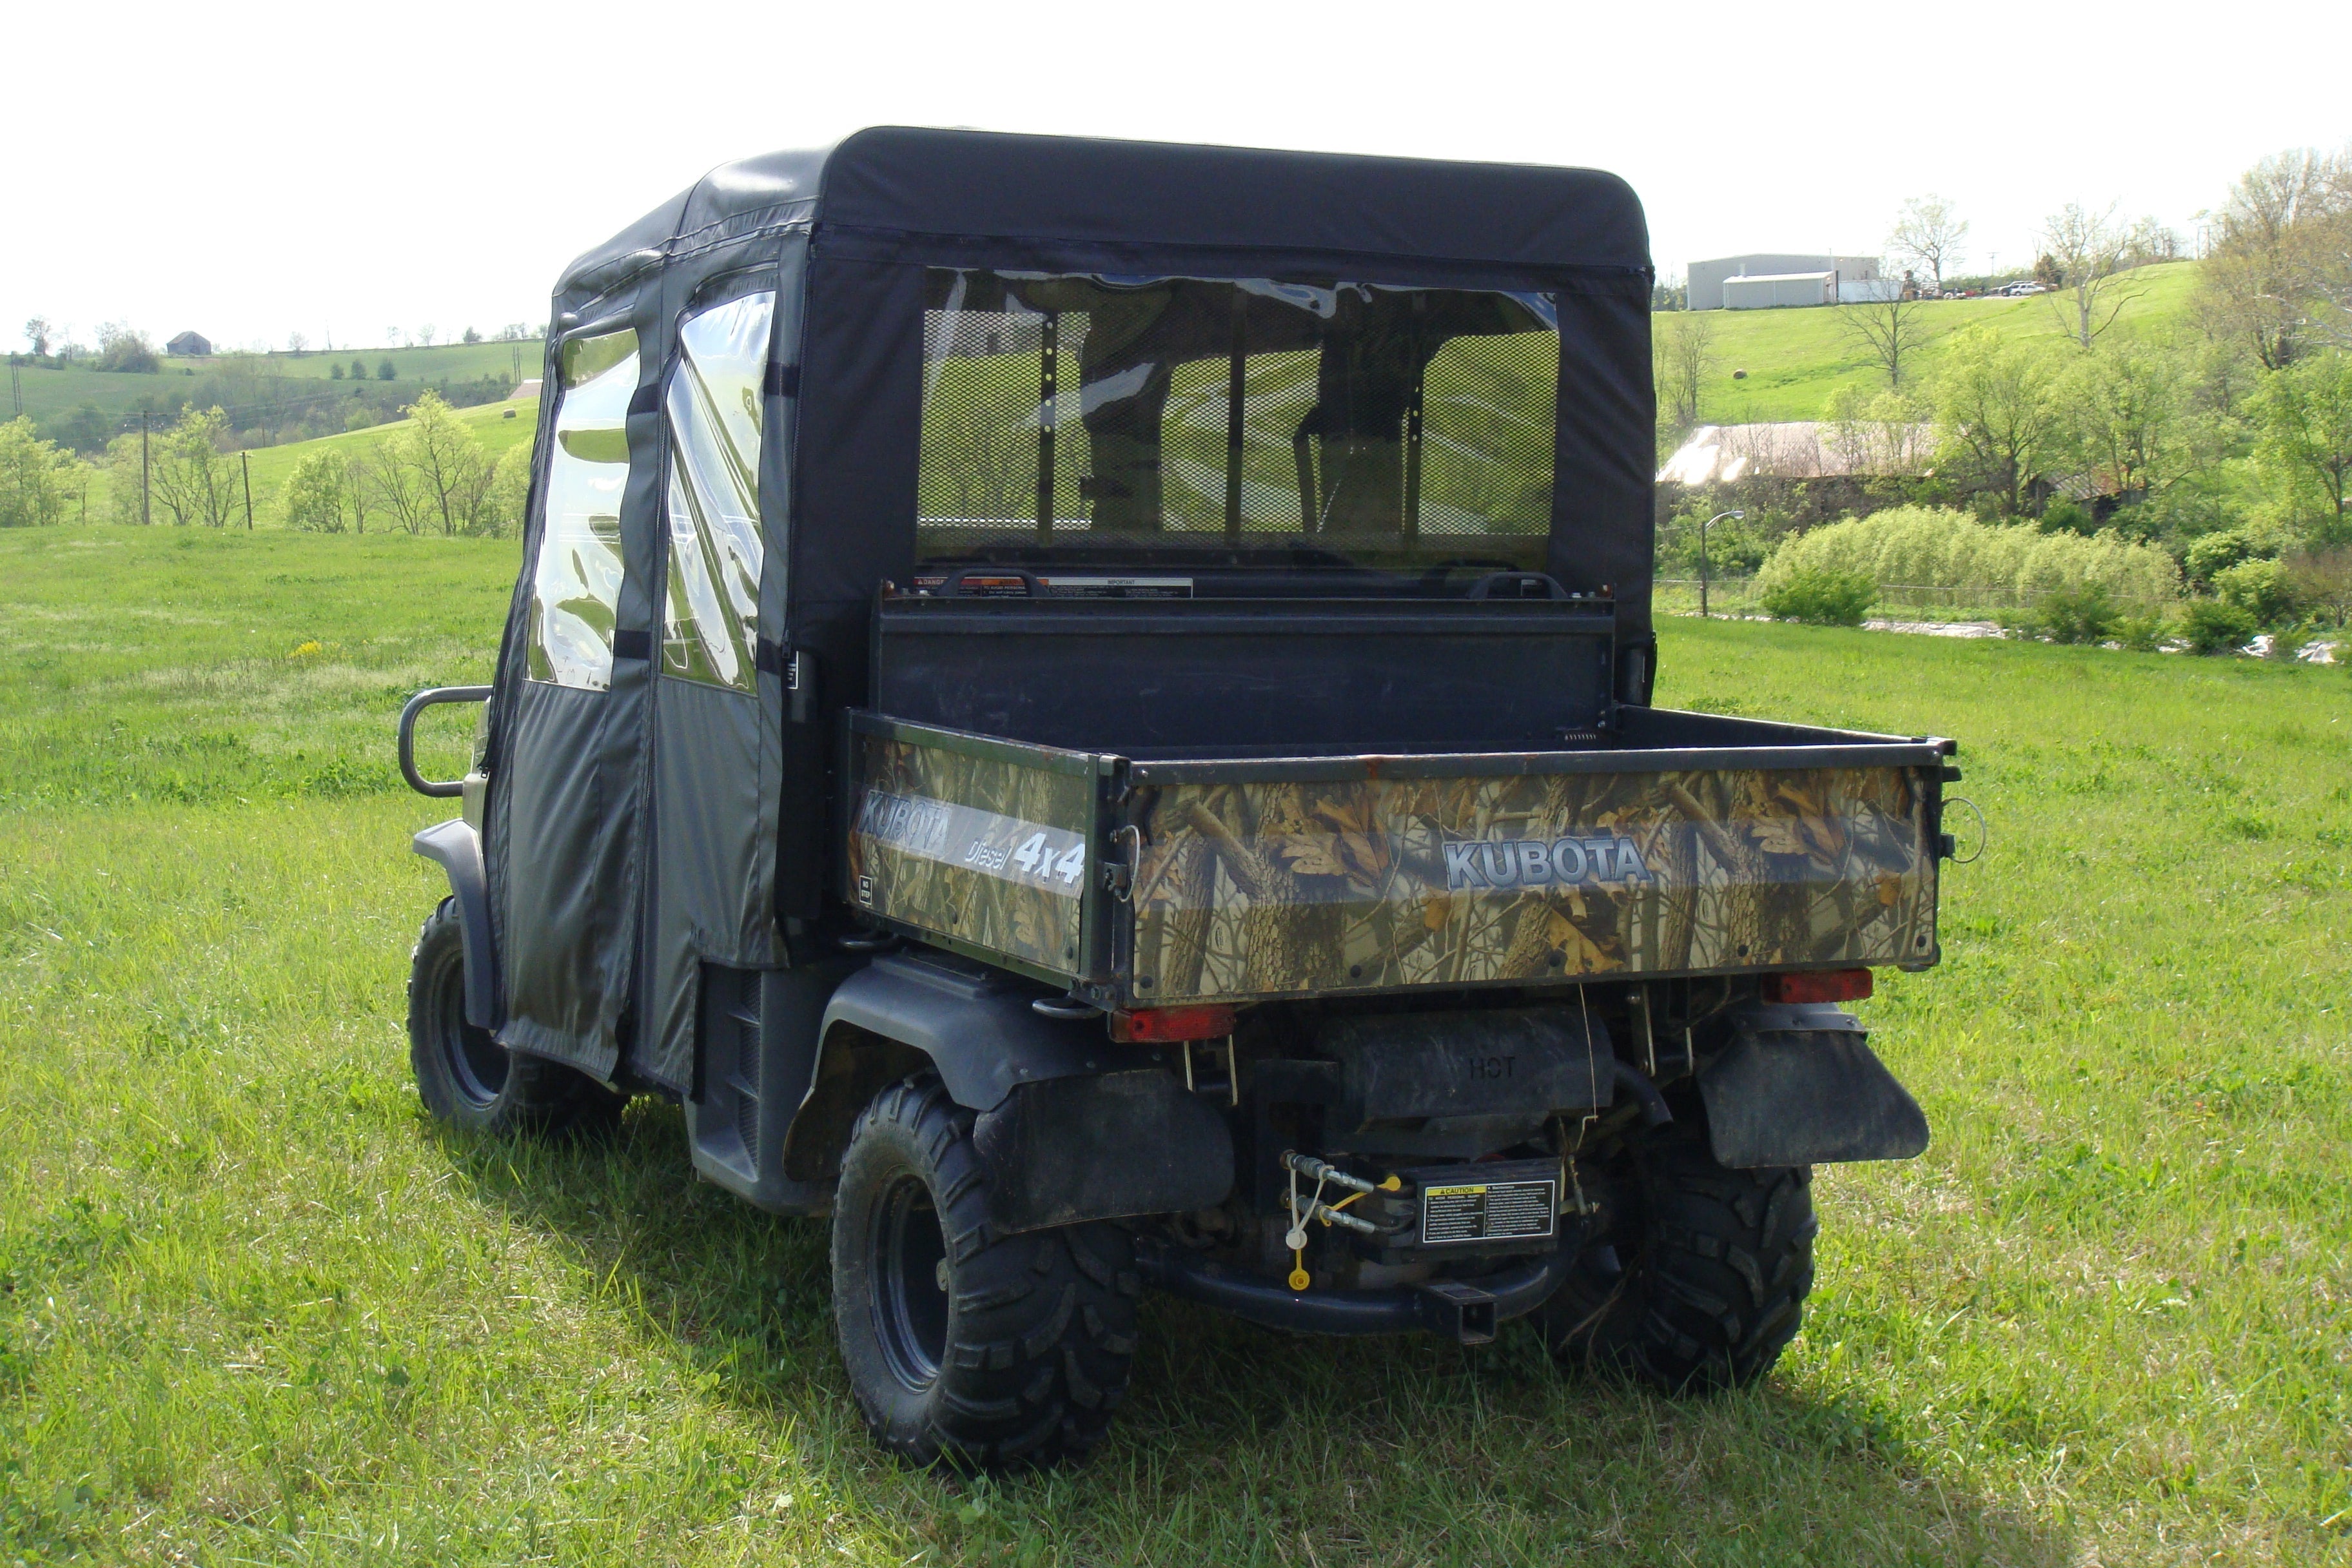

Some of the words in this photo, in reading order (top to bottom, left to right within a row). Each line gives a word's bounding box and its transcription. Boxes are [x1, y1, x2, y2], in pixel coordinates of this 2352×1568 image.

[858, 790, 951, 852] KUBOTA
[965, 838, 1013, 870] Diesel
[1014, 832, 1086, 884] 4x4
[1444, 837, 1652, 889] KUBOTA
[861, 890, 870, 898] STEP
[1469, 1055, 1516, 1079] HOT
